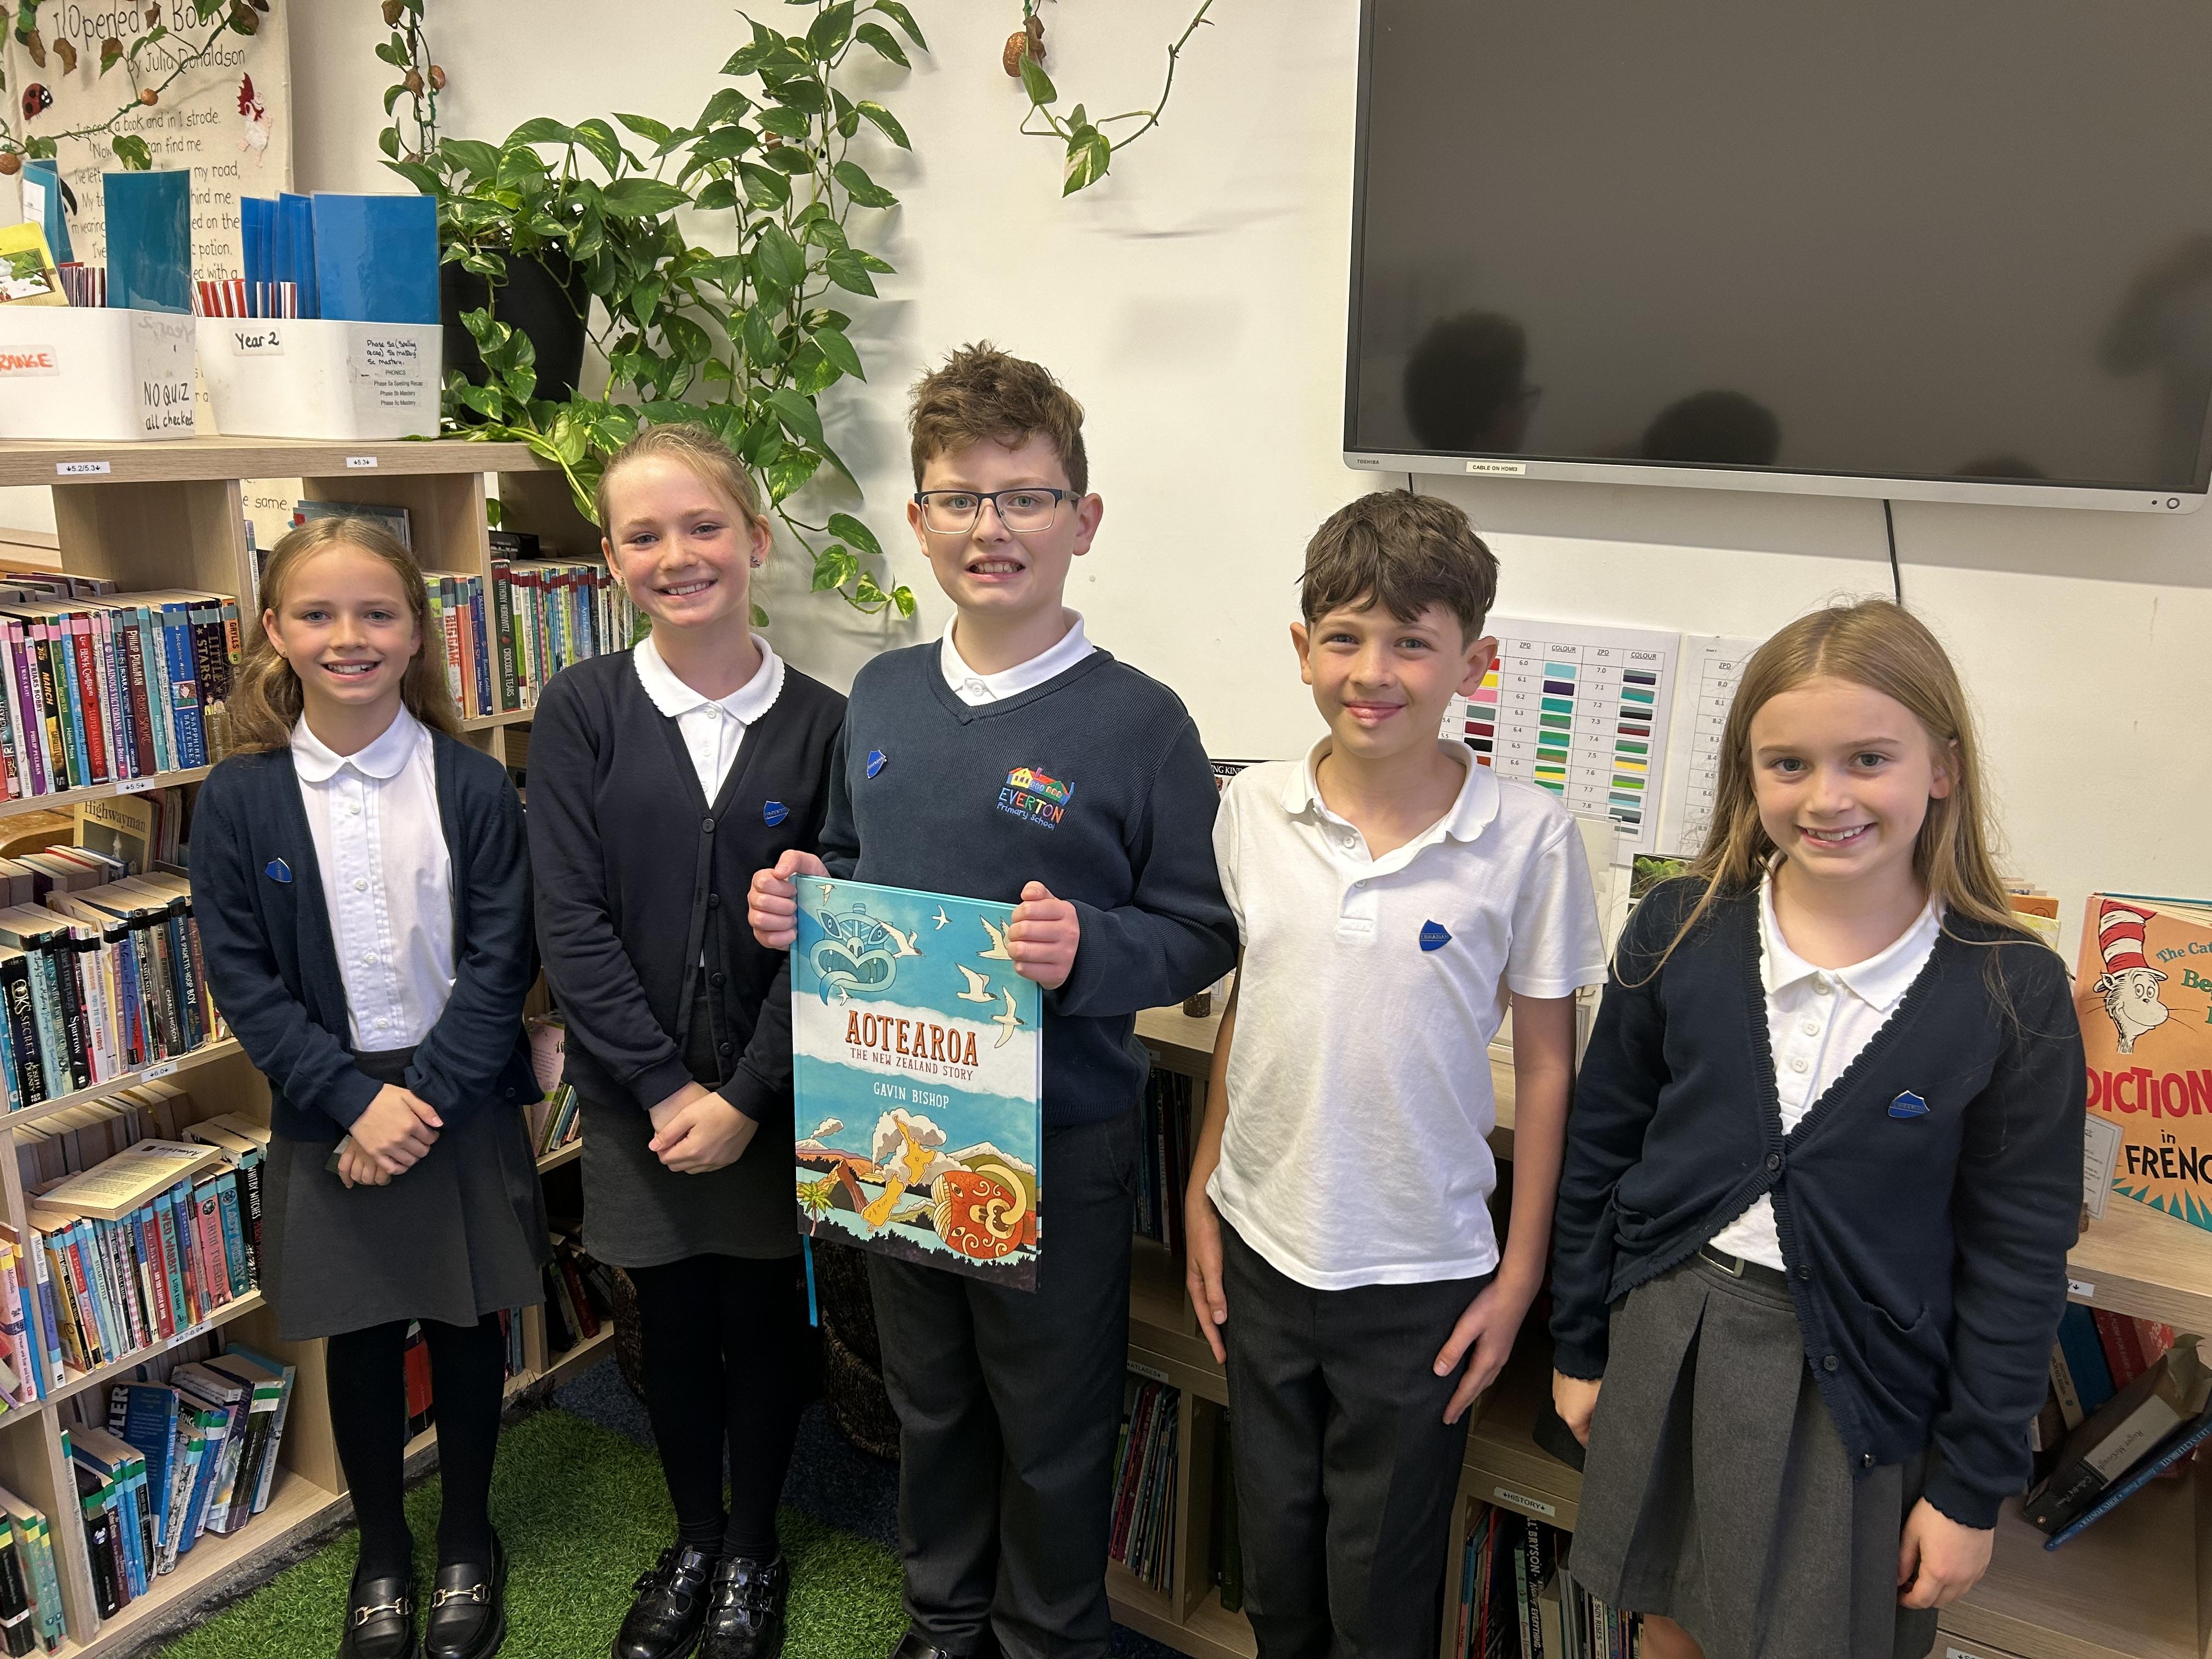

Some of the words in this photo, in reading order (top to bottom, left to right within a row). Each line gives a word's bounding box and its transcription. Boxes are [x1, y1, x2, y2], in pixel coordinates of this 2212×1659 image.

[145, 51, 174, 72] Julia
[178, 44, 245, 69] Donaldson
[115, 121, 120, 132] a
[124, 114, 144, 131] book
[146, 112, 163, 128] and
[168, 114, 175, 128] in
[179, 111, 183, 127] I
[187, 110, 221, 126] strode.
[92, 143, 112, 159] Now
[166, 137, 183, 154] find
[187, 140, 204, 152] me.
[194, 167, 208, 182] my
[212, 161, 241, 179] road,
[215, 193, 234, 205] me.
[207, 217, 218, 229] on
[221, 212, 240, 229] the
[200, 239, 232, 259] potion.
[207, 263, 228, 280] with
[232, 269, 238, 279] a
[235, 332, 265, 349] Year
[268, 331, 279, 346] 2
[144, 381, 160, 407] NO
[163, 382, 189, 407] QUIZ
[146, 413, 159, 430] all
[163, 410, 193, 428] checked
[255, 495, 290, 511] same.
[445, 614, 458, 636] BIG
[500, 604, 510, 633] HOROWITZ
[126, 630, 139, 652] PHILIP
[230, 622, 239, 649] GRYLLS
[197, 639, 211, 681] STARS
[208, 636, 223, 682] LITTLE
[448, 637, 460, 668] GAME
[503, 648, 514, 678] CROCODILE
[1551, 645, 1576, 653] COLOUR
[1631, 652, 1656, 660] COLOUR
[106, 654, 117, 691] VILLAINOUS
[129, 654, 143, 686] PULLMAN
[42, 672, 53, 705] MARCH
[506, 678, 515, 697] TEARS
[35, 690, 43, 713] BOBBY
[110, 692, 122, 730] VICTORIANS
[184, 714, 195, 764] BATTERSEA
[190, 716, 200, 760] SAPPHIRE
[212, 717, 221, 744] Jacqueline
[91, 730, 102, 765] ALEXANDER
[33, 750, 41, 775] PULLMAN
[84, 800, 146, 833] Highwayman
[997, 802, 1029, 820] Primary
[1030, 814, 1056, 831] School
[998, 787, 1065, 823] EVERTON
[2156, 947, 2186, 963] The
[2188, 941, 2212, 955] Cat
[88, 965, 96, 990] JOHNSON
[180, 943, 193, 988] SPAGHETTI-HOOP
[187, 989, 196, 1005] BOY
[51, 980, 60, 1001] NABB
[63, 970, 75, 1012] morpurgo
[166, 990, 174, 1016] CHARLIE
[54, 1005, 64, 1036] Twilight
[169, 1017, 177, 1042] HIGSON
[20, 1016, 35, 1055] SECRET
[68, 1015, 81, 1054] Sparrow
[845, 1009, 979, 1068] AOTEAROA
[24, 1062, 35, 1093] DELANEY
[31, 1064, 41, 1088] JOSEPH
[850, 1047, 868, 1063] THE
[872, 1052, 892, 1066] NEW
[896, 1056, 939, 1075] ZEALAND
[943, 1064, 973, 1081] STORY
[873, 1081, 907, 1101] GAVIN
[912, 1089, 950, 1109] BISHOP
[2161, 1129, 2176, 1144] in
[247, 1165, 259, 1190] WHITBY
[226, 1204, 239, 1235] LADY
[249, 1193, 261, 1219] WITCHES
[162, 1210, 173, 1235] WED
[206, 1216, 217, 1246] GRIM
[34, 1239, 43, 1262] Michael
[165, 1236, 177, 1275] WABBIT
[230, 1238, 245, 1281] FRIDAY
[94, 1260, 103, 1281] STUART
[115, 1259, 123, 1283] CHEMICAL
[211, 1249, 224, 1295] TUESDAY
[1507, 1494, 1541, 1509] HISTORY
[1527, 1531, 1542, 1573] BRYSON
